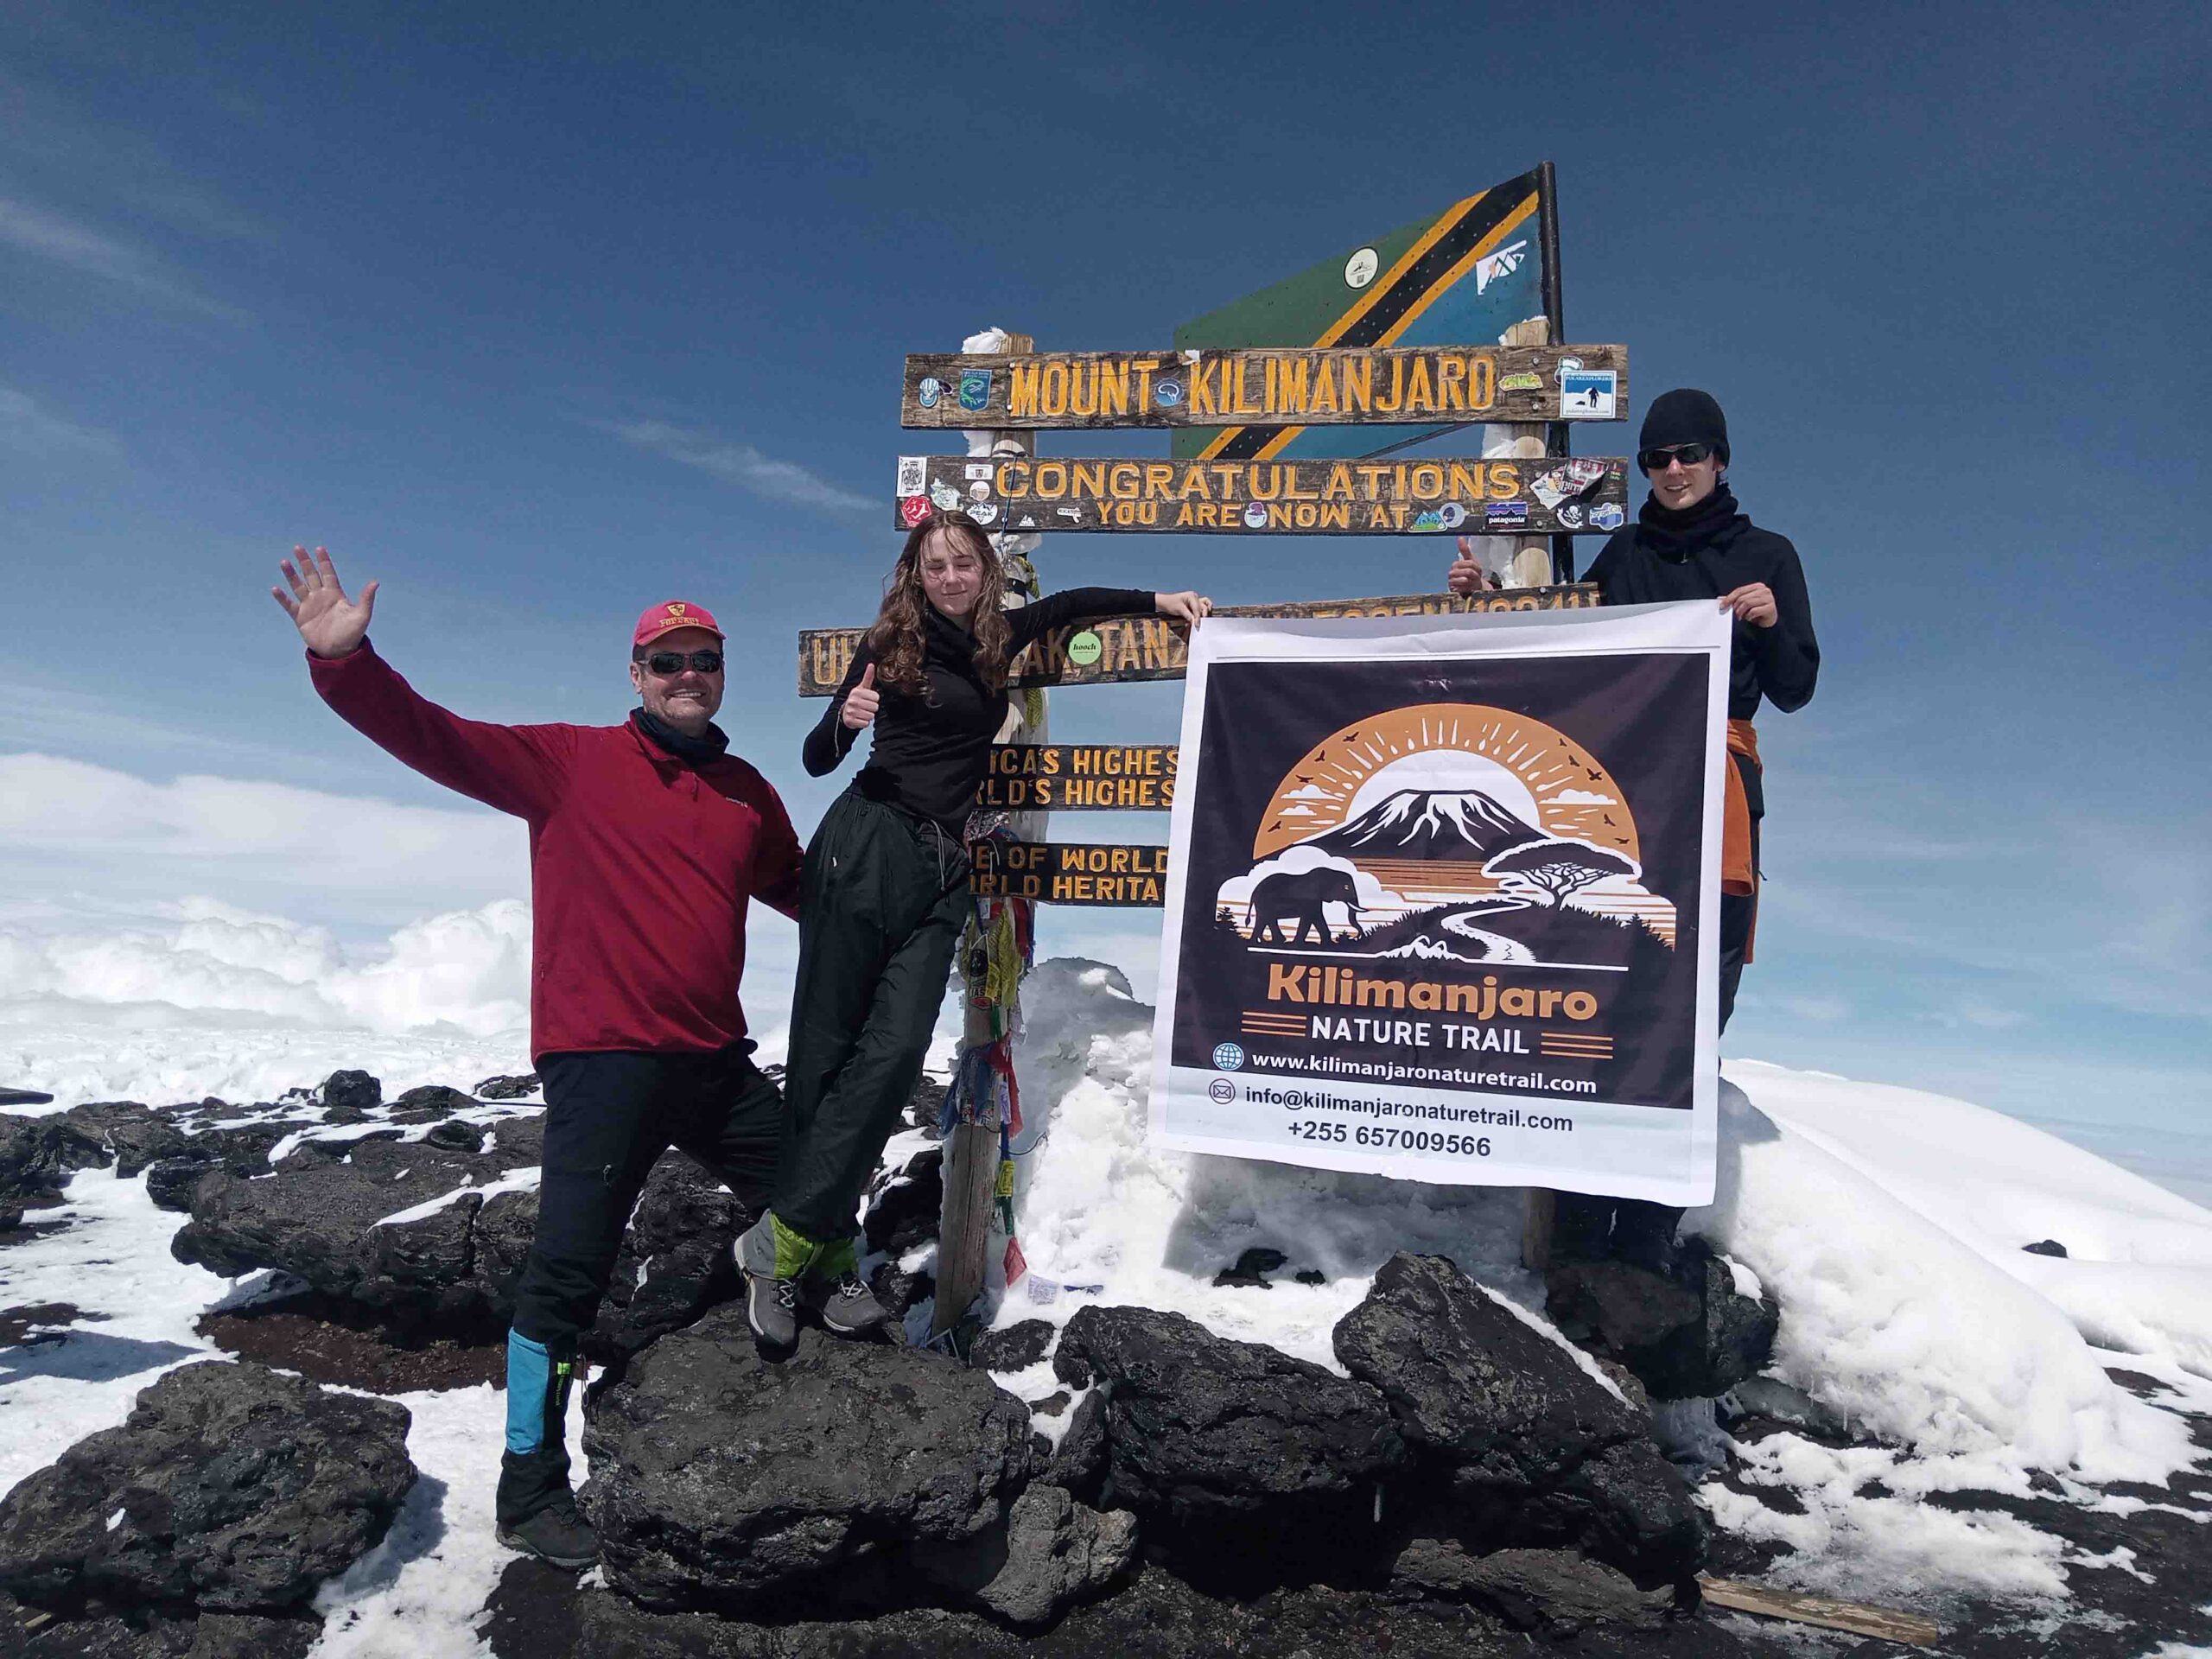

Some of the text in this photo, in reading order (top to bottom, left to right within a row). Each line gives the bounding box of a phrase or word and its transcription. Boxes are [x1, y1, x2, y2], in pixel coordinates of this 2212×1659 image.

[1010, 355, 1494, 416] MOUNT KILIMANJARO
[996, 461, 1520, 500] CONGRATULATIONS
[969, 509, 994, 518] PEAK
[1096, 500, 1410, 529] YOU ARE NOW AT
[1008, 846, 1048, 870] OF
[1268, 963, 1598, 1020] Kilimanjaro
[1312, 1015, 1530, 1054] NATURE TRAIL
[1252, 1052, 1597, 1094] www.kilimanjaronaturetrail.com
[1245, 1085, 1573, 1132] info@kilimanjaronaturetrail.com
[1287, 1120, 1491, 1157] +255 657009566
